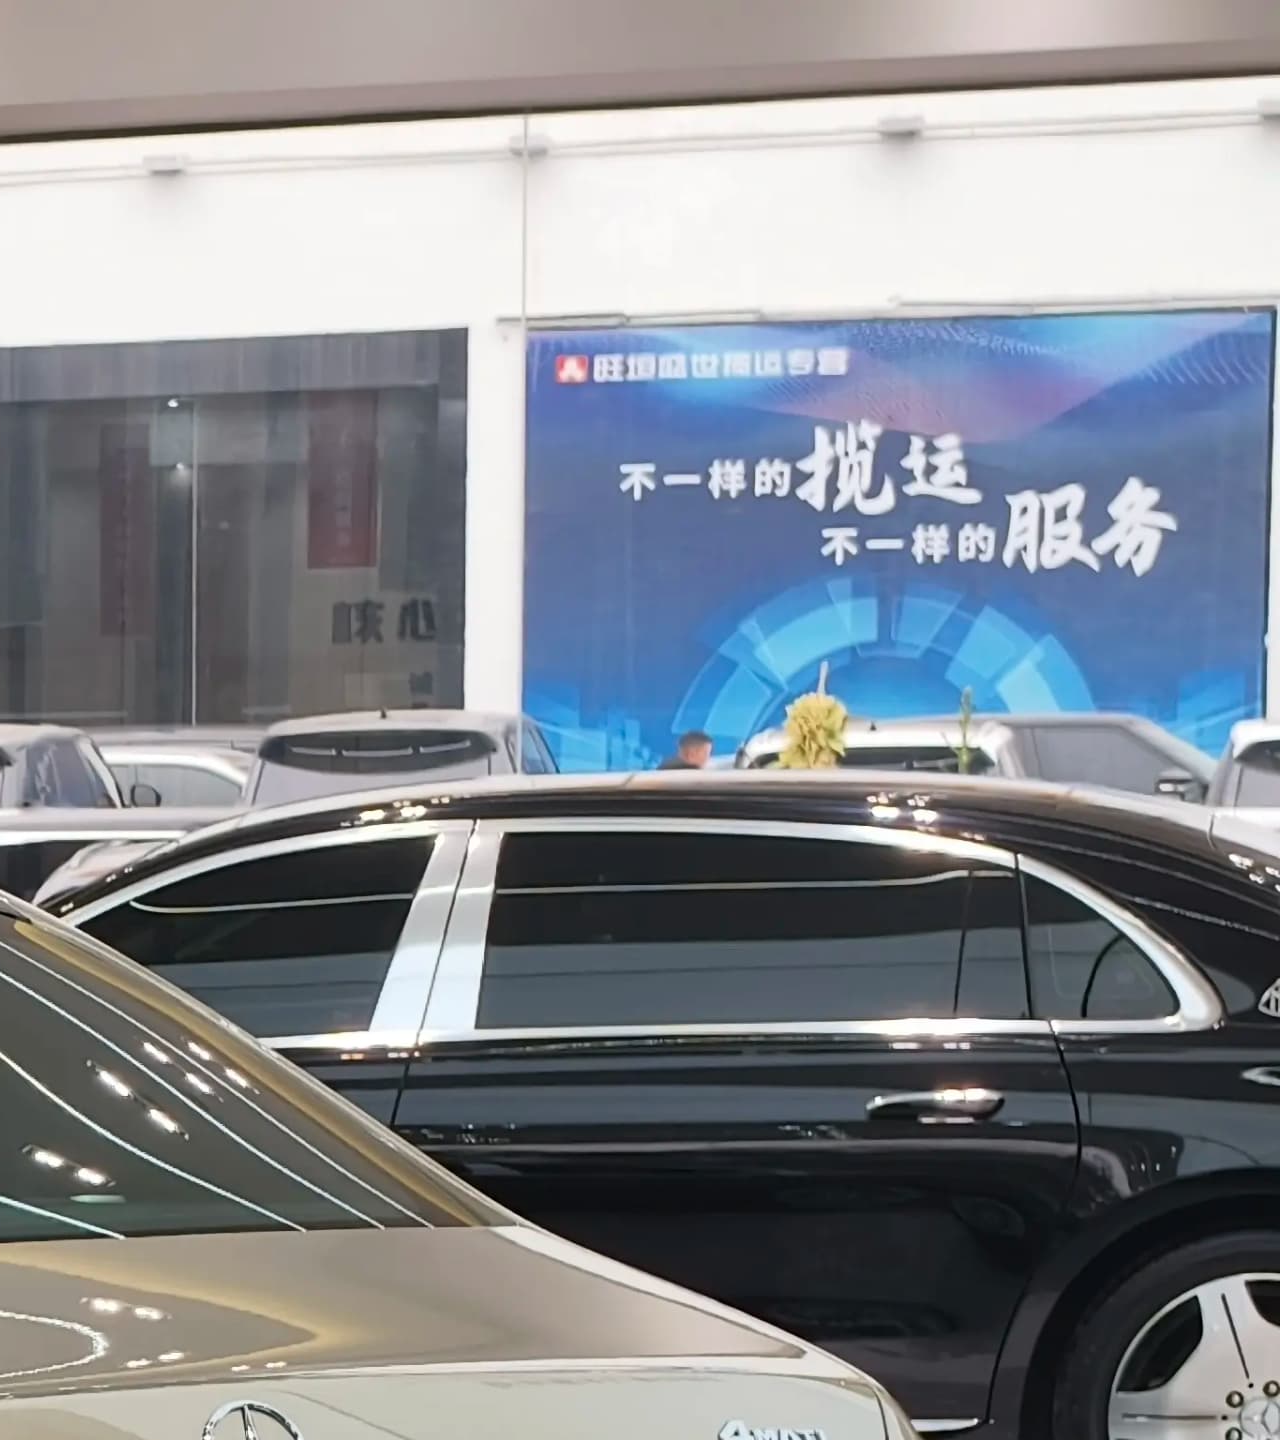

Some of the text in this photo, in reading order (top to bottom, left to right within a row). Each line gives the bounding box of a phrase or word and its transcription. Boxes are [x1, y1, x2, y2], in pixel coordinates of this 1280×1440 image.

[618, 417, 984, 516] 不一样的揽运
[820, 476, 1178, 577] 不一样的服务
